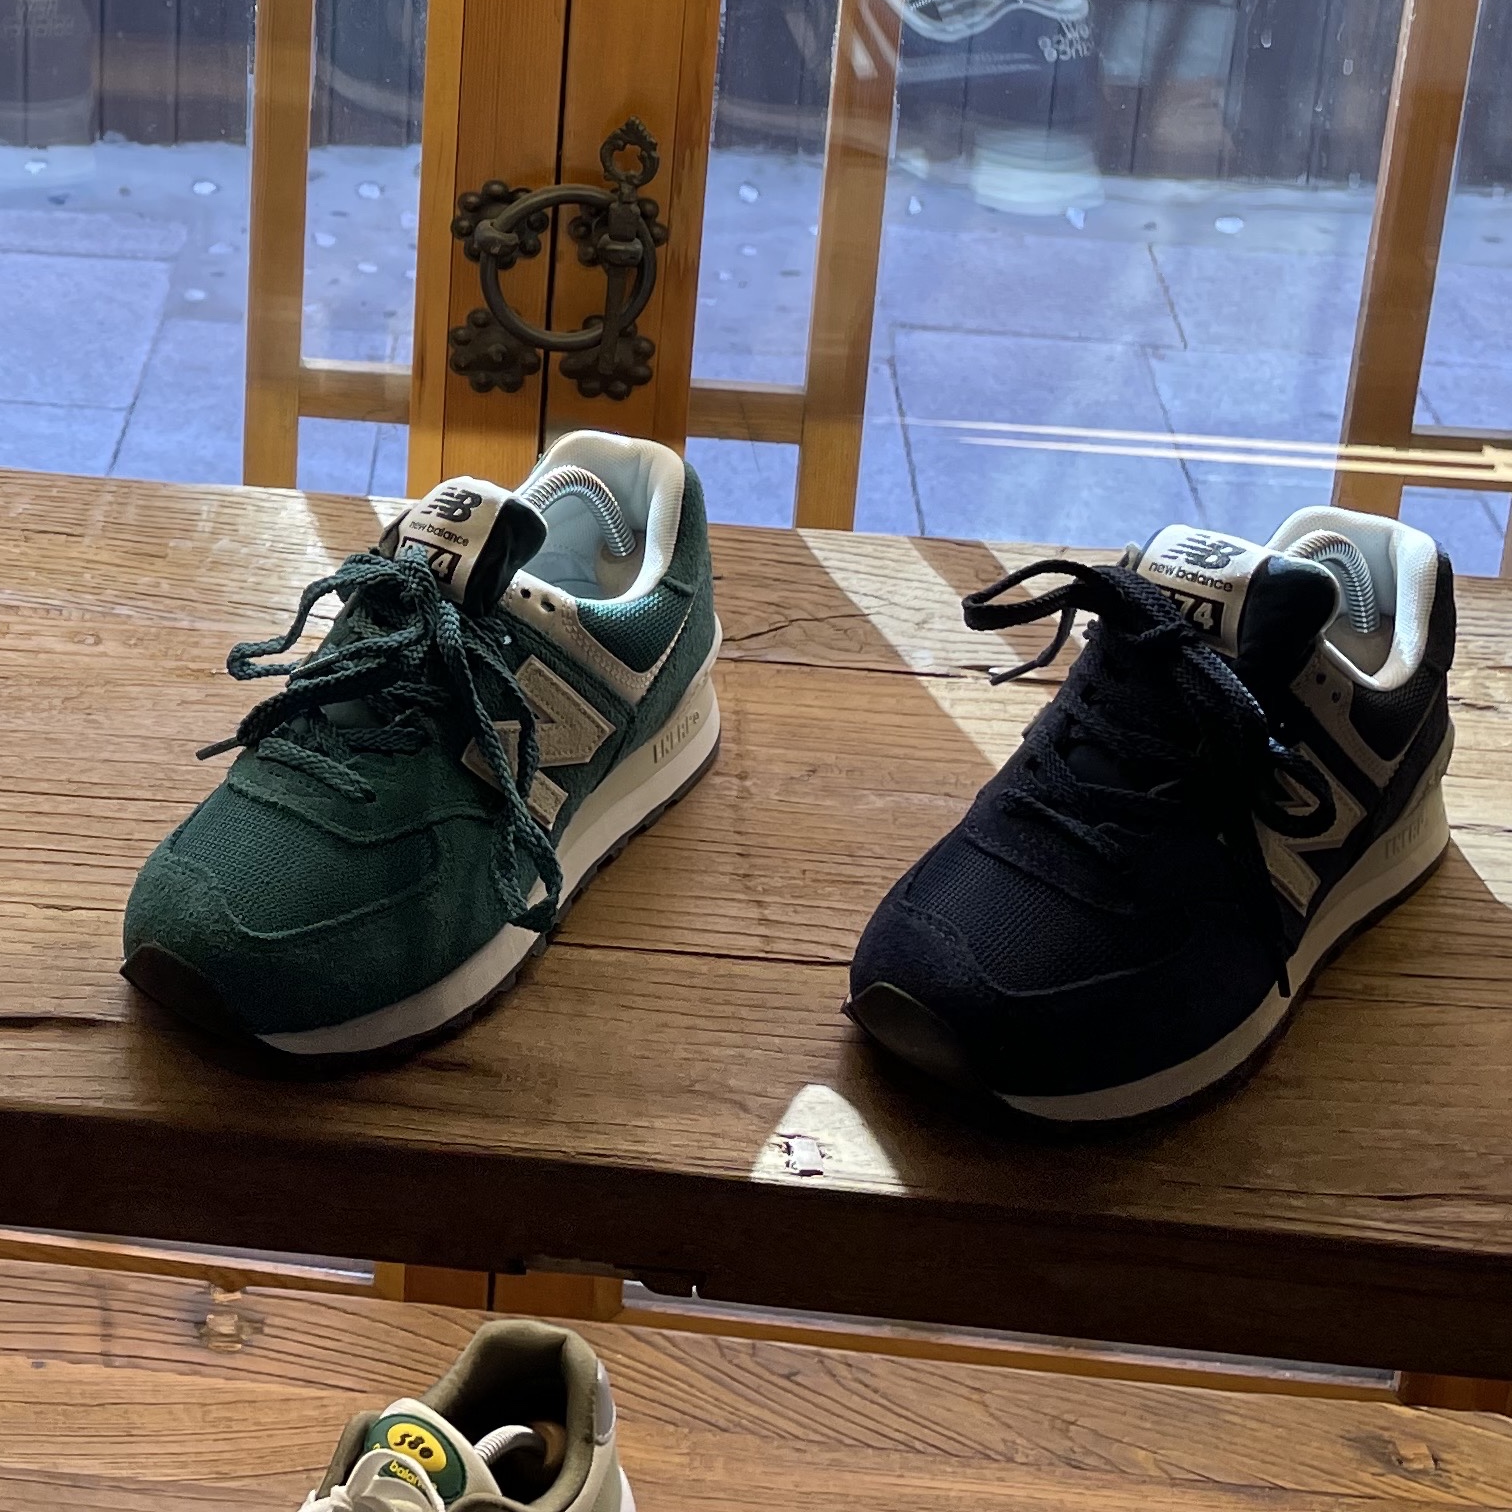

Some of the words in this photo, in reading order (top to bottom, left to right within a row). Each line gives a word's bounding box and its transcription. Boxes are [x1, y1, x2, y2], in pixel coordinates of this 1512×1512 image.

[420, 486, 483, 523] NB
[426, 524, 470, 547] balance
[1160, 533, 1247, 569] NB
[1148, 561, 1177, 577] new
[1176, 566, 1234, 592] balance
[1160, 589, 1214, 630] 74
[392, 1433, 434, 1459] 580
